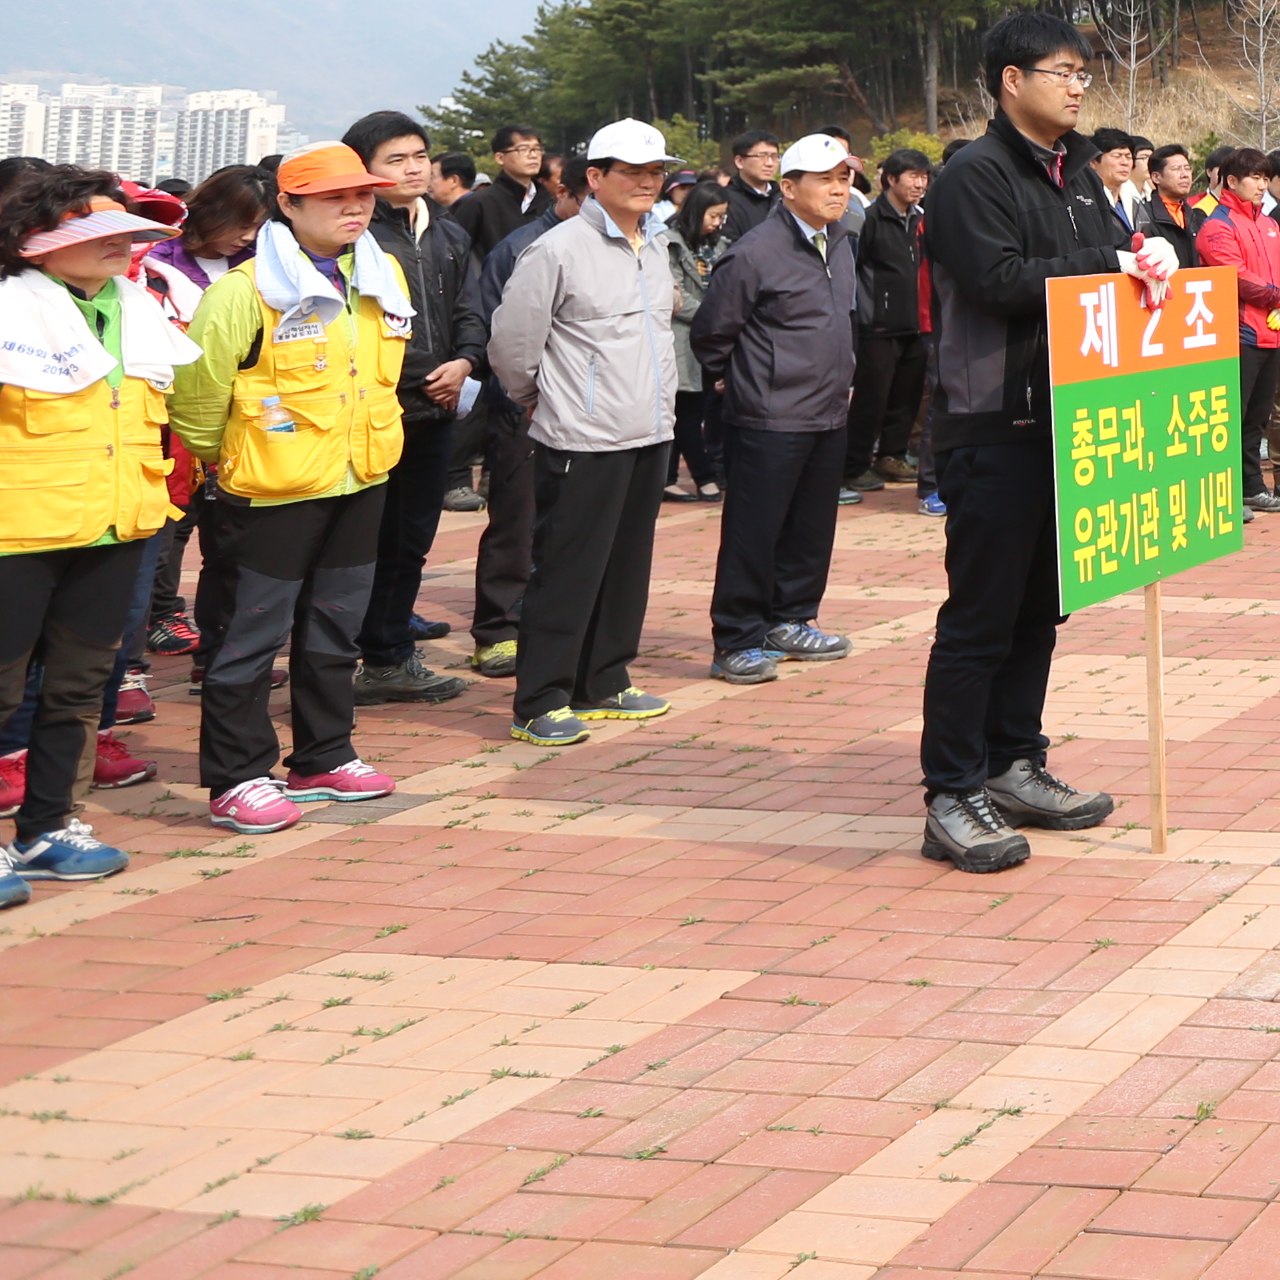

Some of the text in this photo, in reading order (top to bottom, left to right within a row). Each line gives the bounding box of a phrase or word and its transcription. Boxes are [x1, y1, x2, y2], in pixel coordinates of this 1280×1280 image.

[1071, 385, 1230, 487] 총무과, 소주동
[1073, 467, 1234, 583] 유관기관 및 시민
